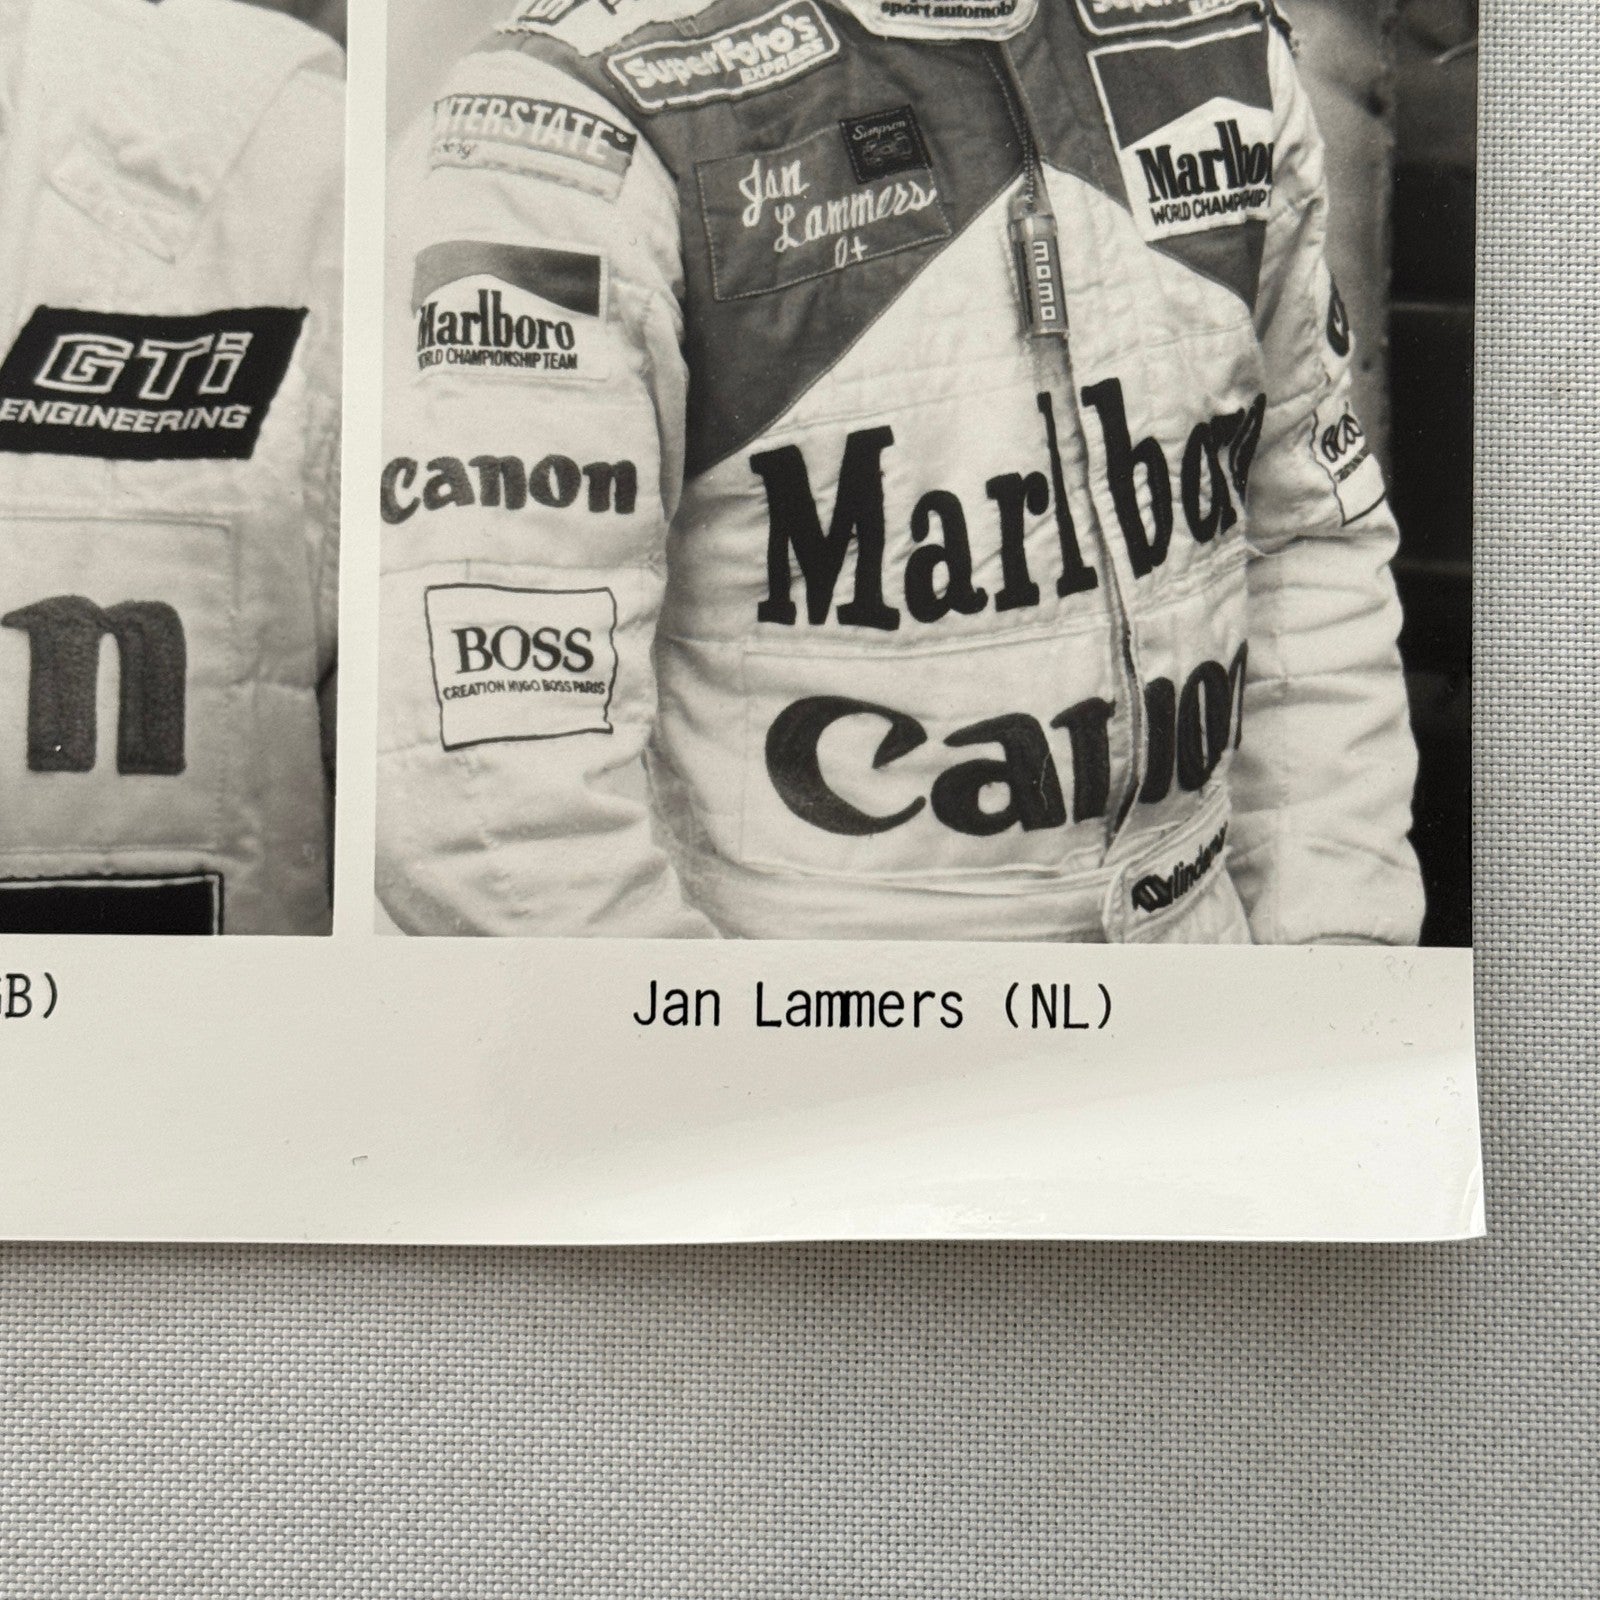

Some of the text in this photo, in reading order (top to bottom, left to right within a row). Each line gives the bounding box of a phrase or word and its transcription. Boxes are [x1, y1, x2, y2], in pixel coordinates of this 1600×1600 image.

[739, 159, 810, 227] Jan
[774, 181, 938, 252] Lammers
[1150, 201, 1192, 226] WORLD
[1033, 241, 1057, 321] momo
[416, 289, 576, 351] Marlboro
[446, 348, 541, 369] CHAMPIONSHIP
[0, 398, 251, 433] ENGINEERING
[380, 454, 637, 524] Canon
[451, 625, 594, 674] BOSS
[443, 679, 606, 701] CREATION HUGO BOSS PARIS
[0, 972, 58, 1019] B)
[633, 981, 1112, 1030] Jan Lammers (NL)
